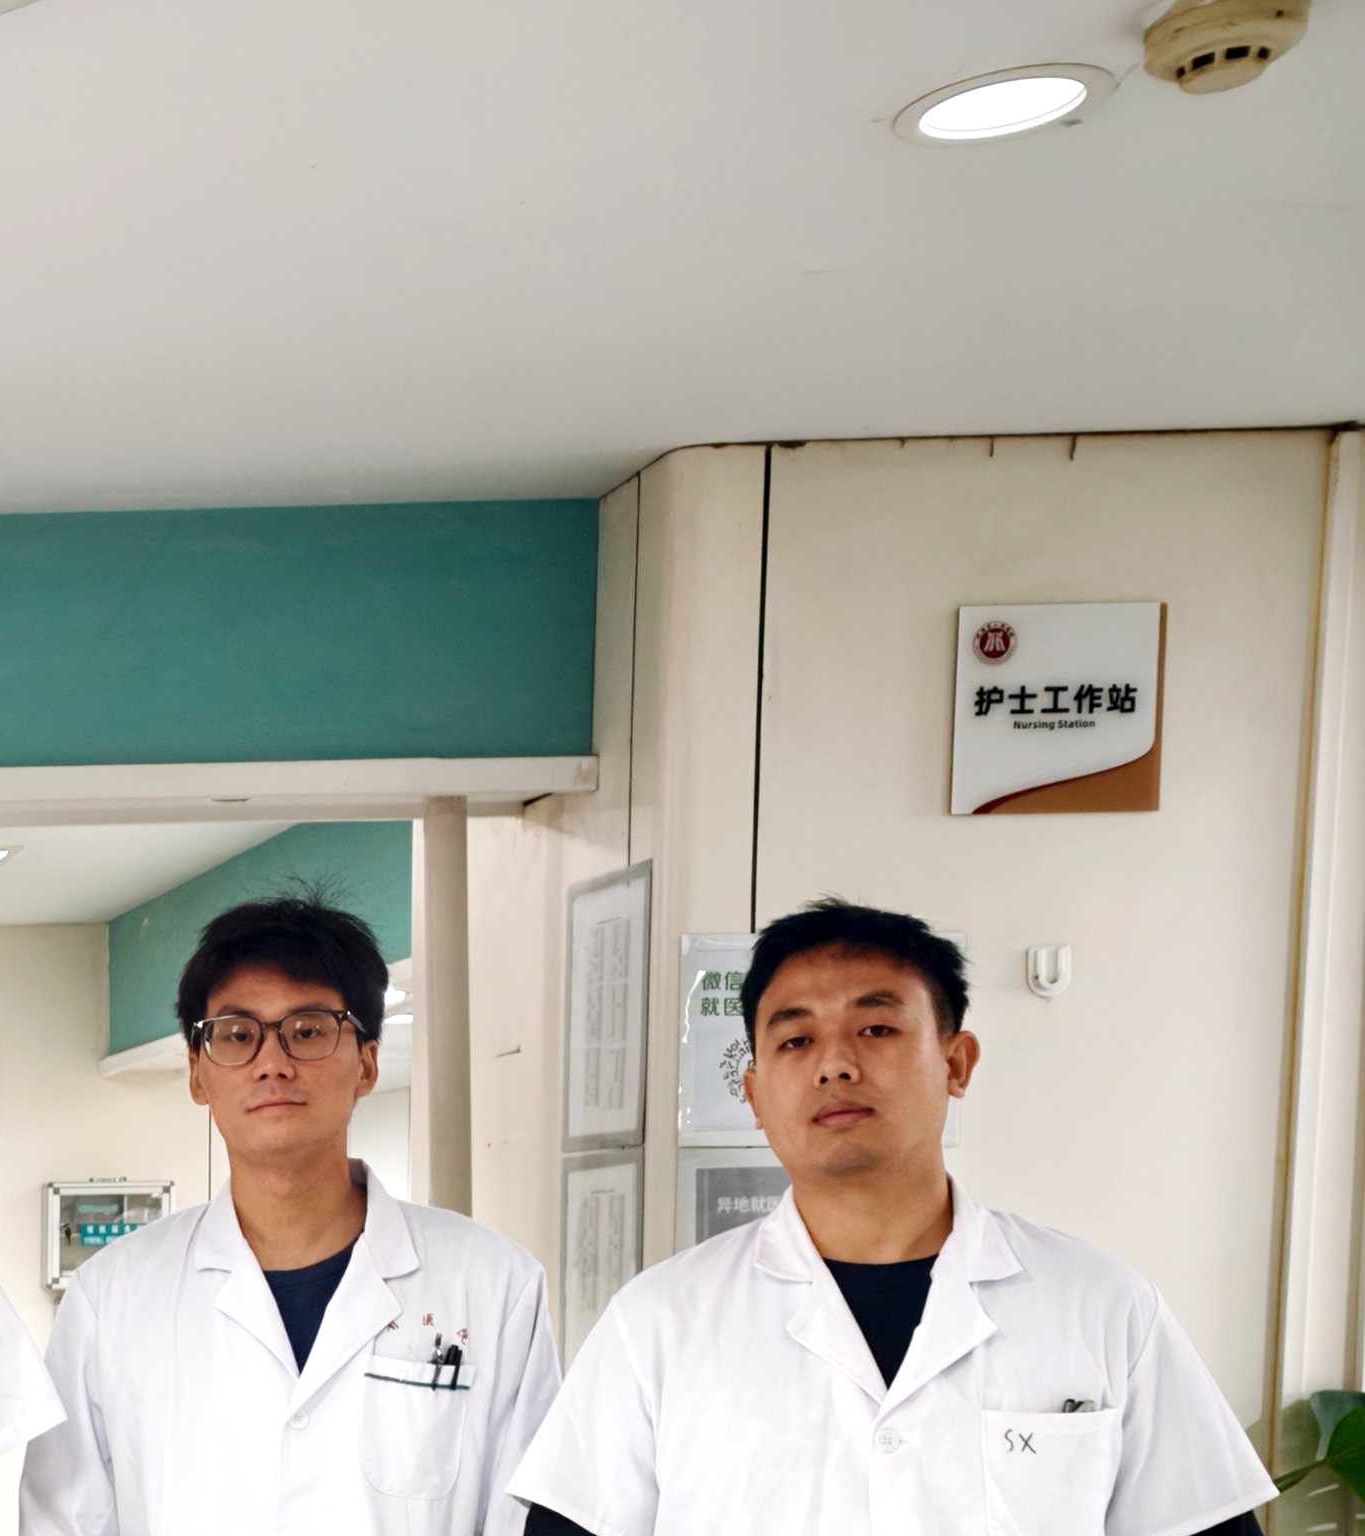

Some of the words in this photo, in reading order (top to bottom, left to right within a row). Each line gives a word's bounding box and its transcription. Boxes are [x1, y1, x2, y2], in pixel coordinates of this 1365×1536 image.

[974, 683, 1138, 717] 护士工作站
[1013, 720, 1055, 731] Nursing
[1057, 719, 1096, 729] Station
